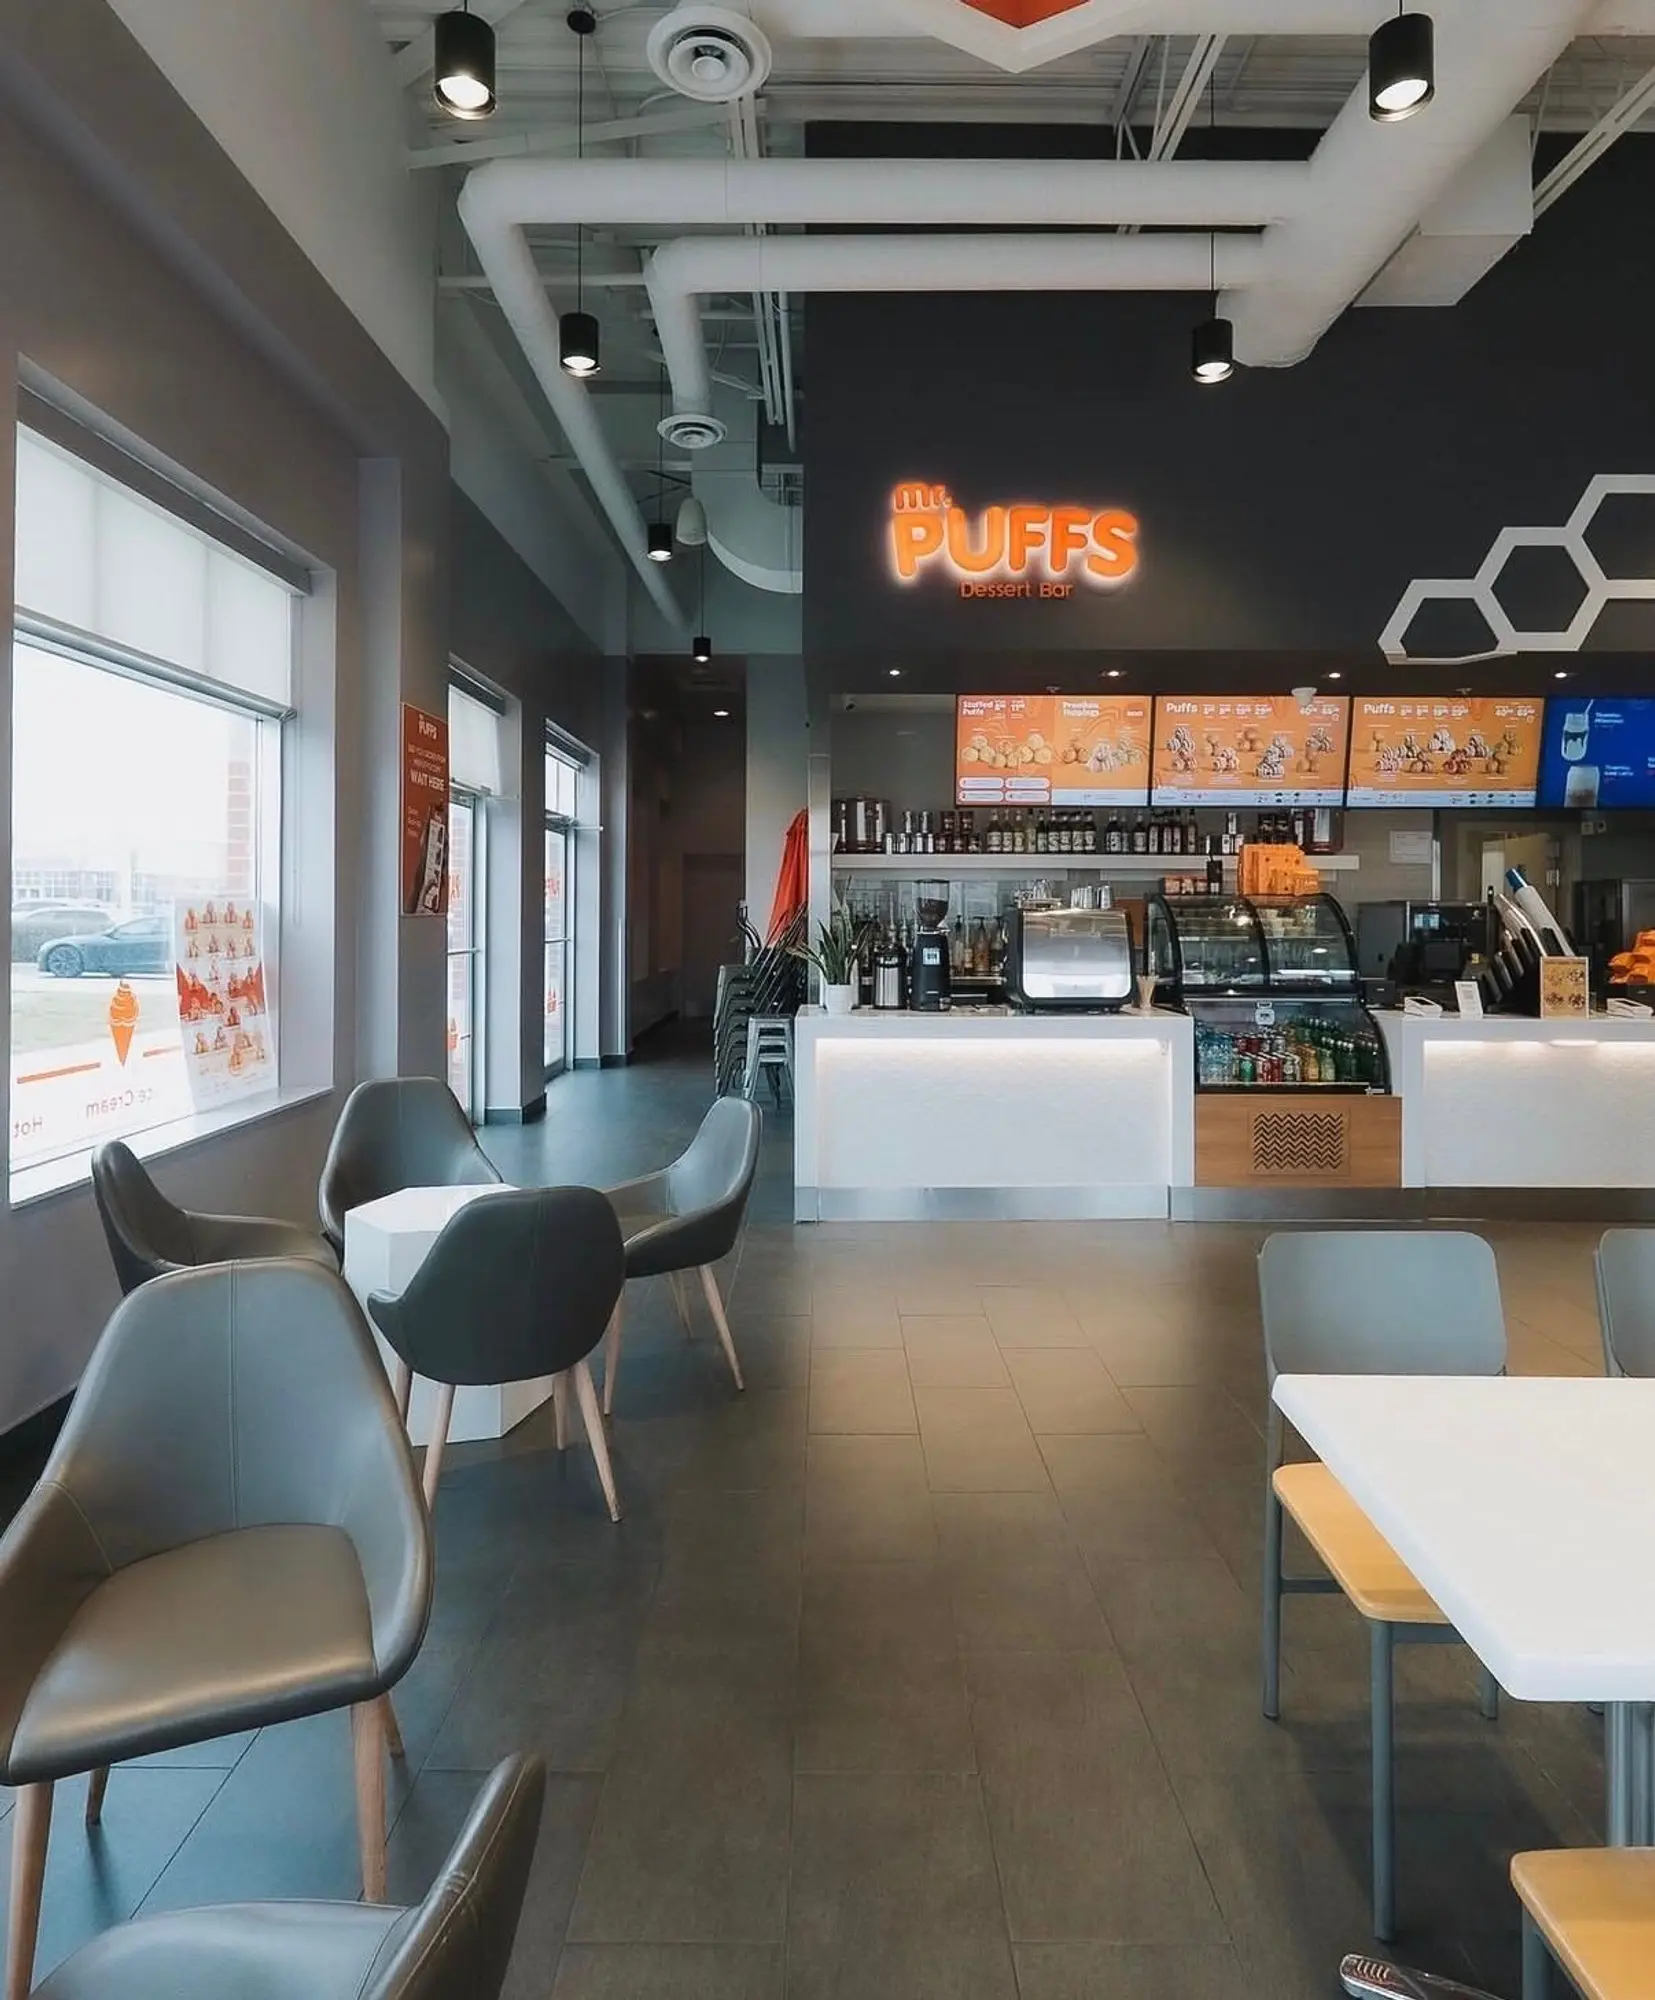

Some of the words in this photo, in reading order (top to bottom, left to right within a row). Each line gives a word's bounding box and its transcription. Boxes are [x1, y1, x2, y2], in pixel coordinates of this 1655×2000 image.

[893, 505, 1139, 578] PUFFS
[961, 581, 1032, 598] Dessert
[1040, 582, 1073, 598] Bar
[1166, 702, 1198, 713] Puffs
[1363, 703, 1396, 715] Puffs
[410, 767, 428, 787] WAIT
